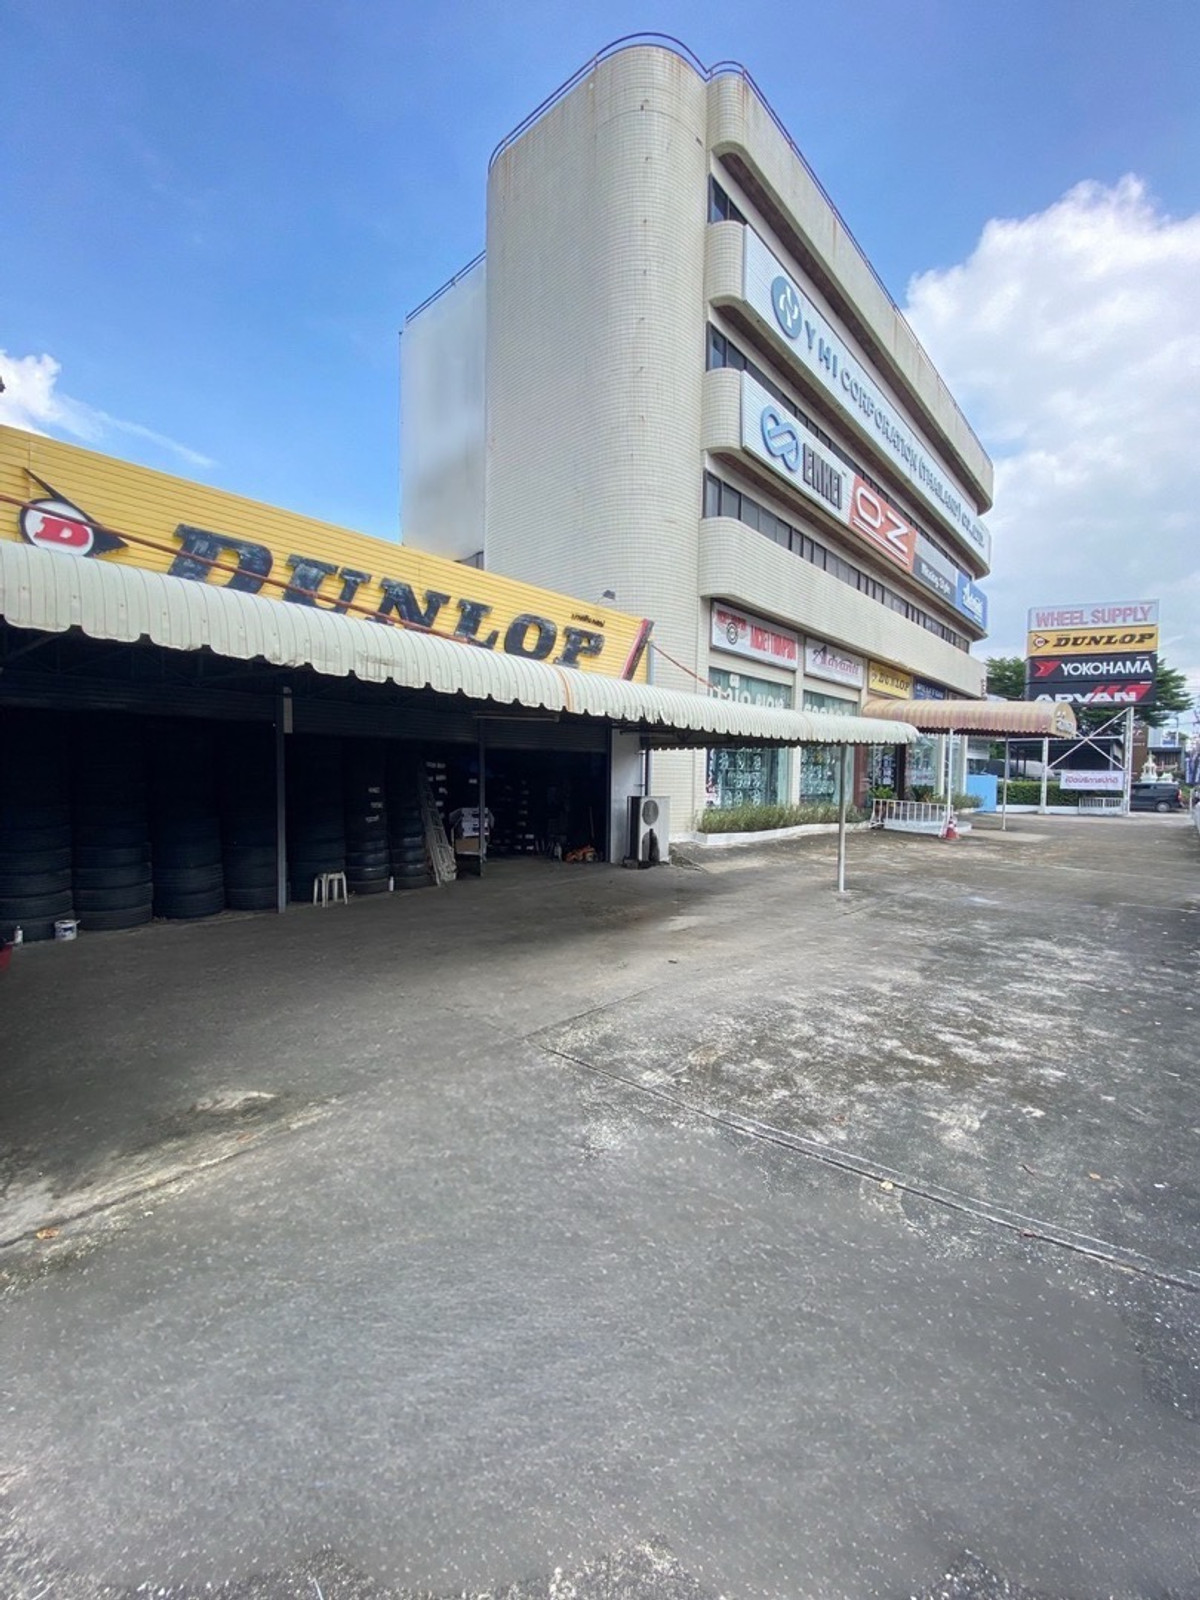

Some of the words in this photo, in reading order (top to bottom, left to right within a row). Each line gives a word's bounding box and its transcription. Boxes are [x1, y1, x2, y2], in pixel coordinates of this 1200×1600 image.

[804, 319, 838, 379] YHI
[840, 368, 918, 472] CORPORATION
[802, 442, 843, 511] ENKEI
[856, 486, 911, 554] OZ
[167, 523, 605, 669] DUNLOP
[1036, 610, 1088, 627] WHEEL
[1091, 606, 1153, 624] SUPPLY
[1053, 633, 1155, 647] DUNLOP
[1061, 661, 1153, 676] YOKOHAMA
